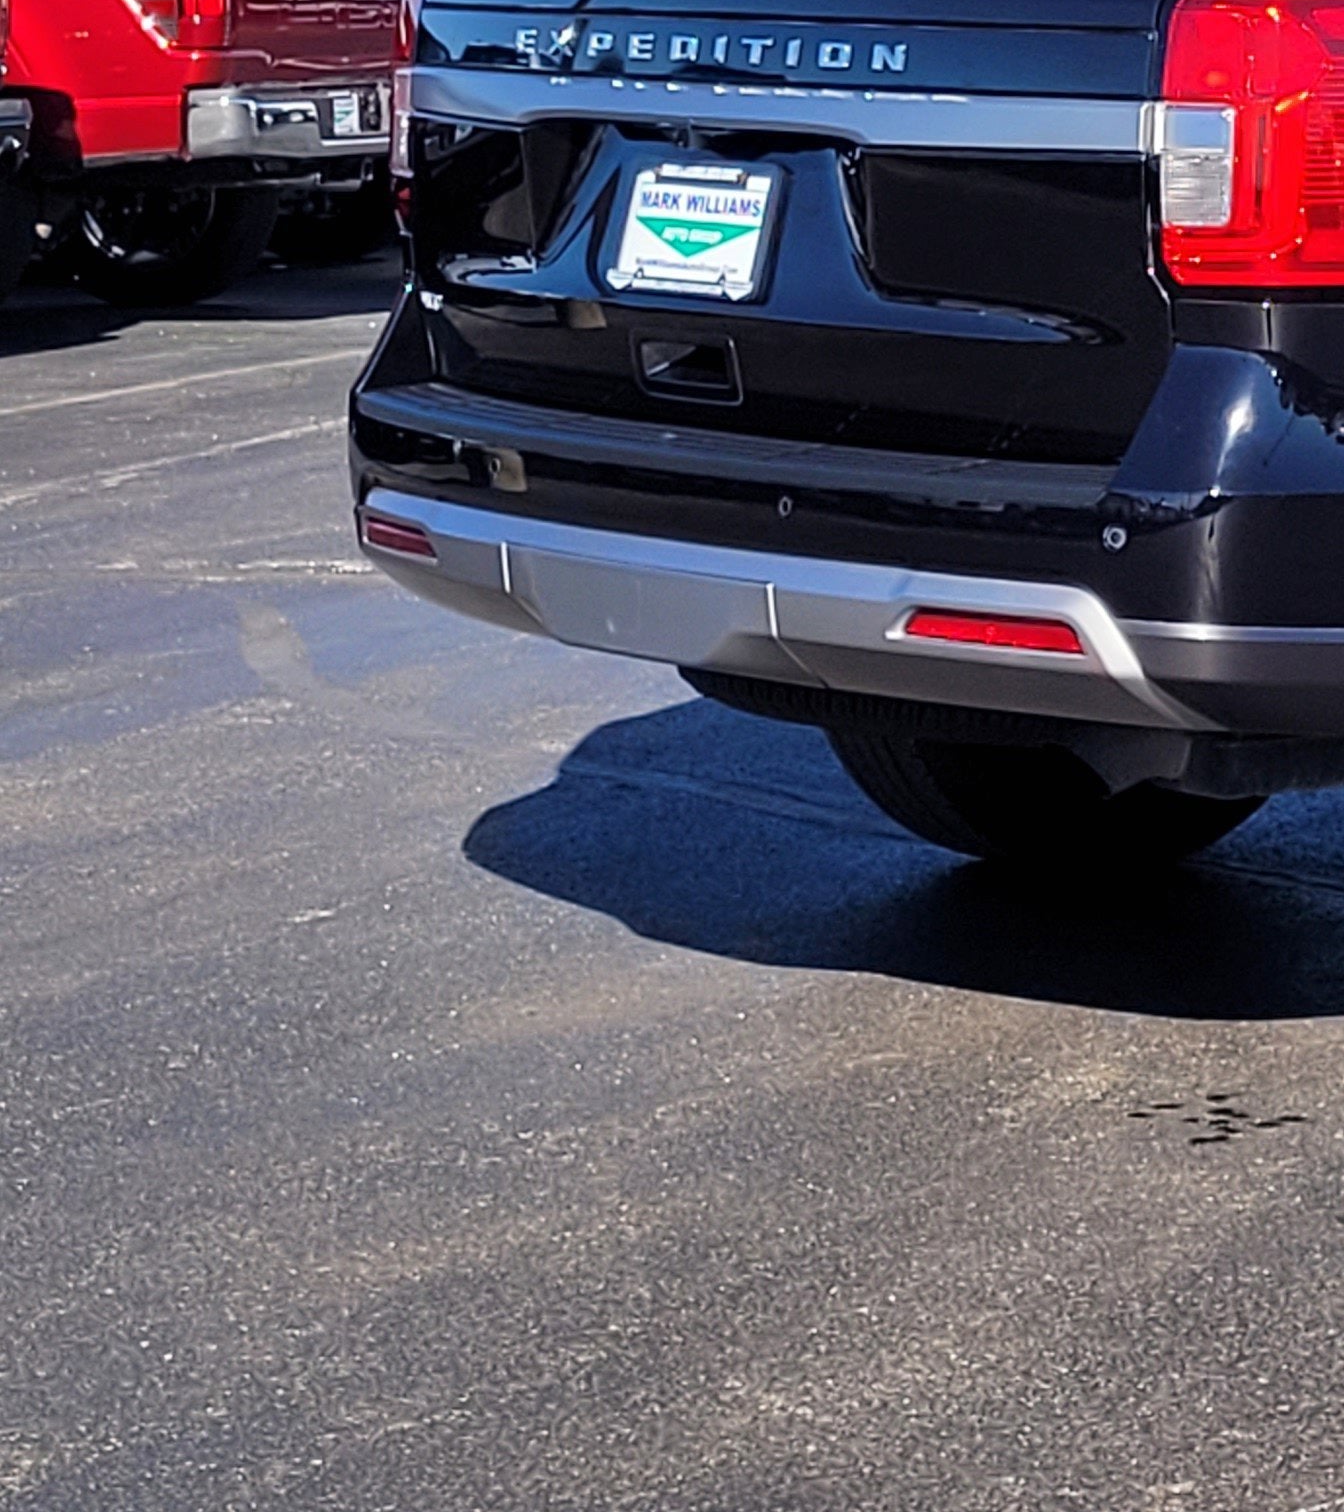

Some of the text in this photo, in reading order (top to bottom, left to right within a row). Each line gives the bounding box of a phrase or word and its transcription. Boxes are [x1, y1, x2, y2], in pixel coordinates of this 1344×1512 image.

[514, 28, 908, 72] EXPEDITION
[641, 190, 761, 218] MARK WILLIAMS
